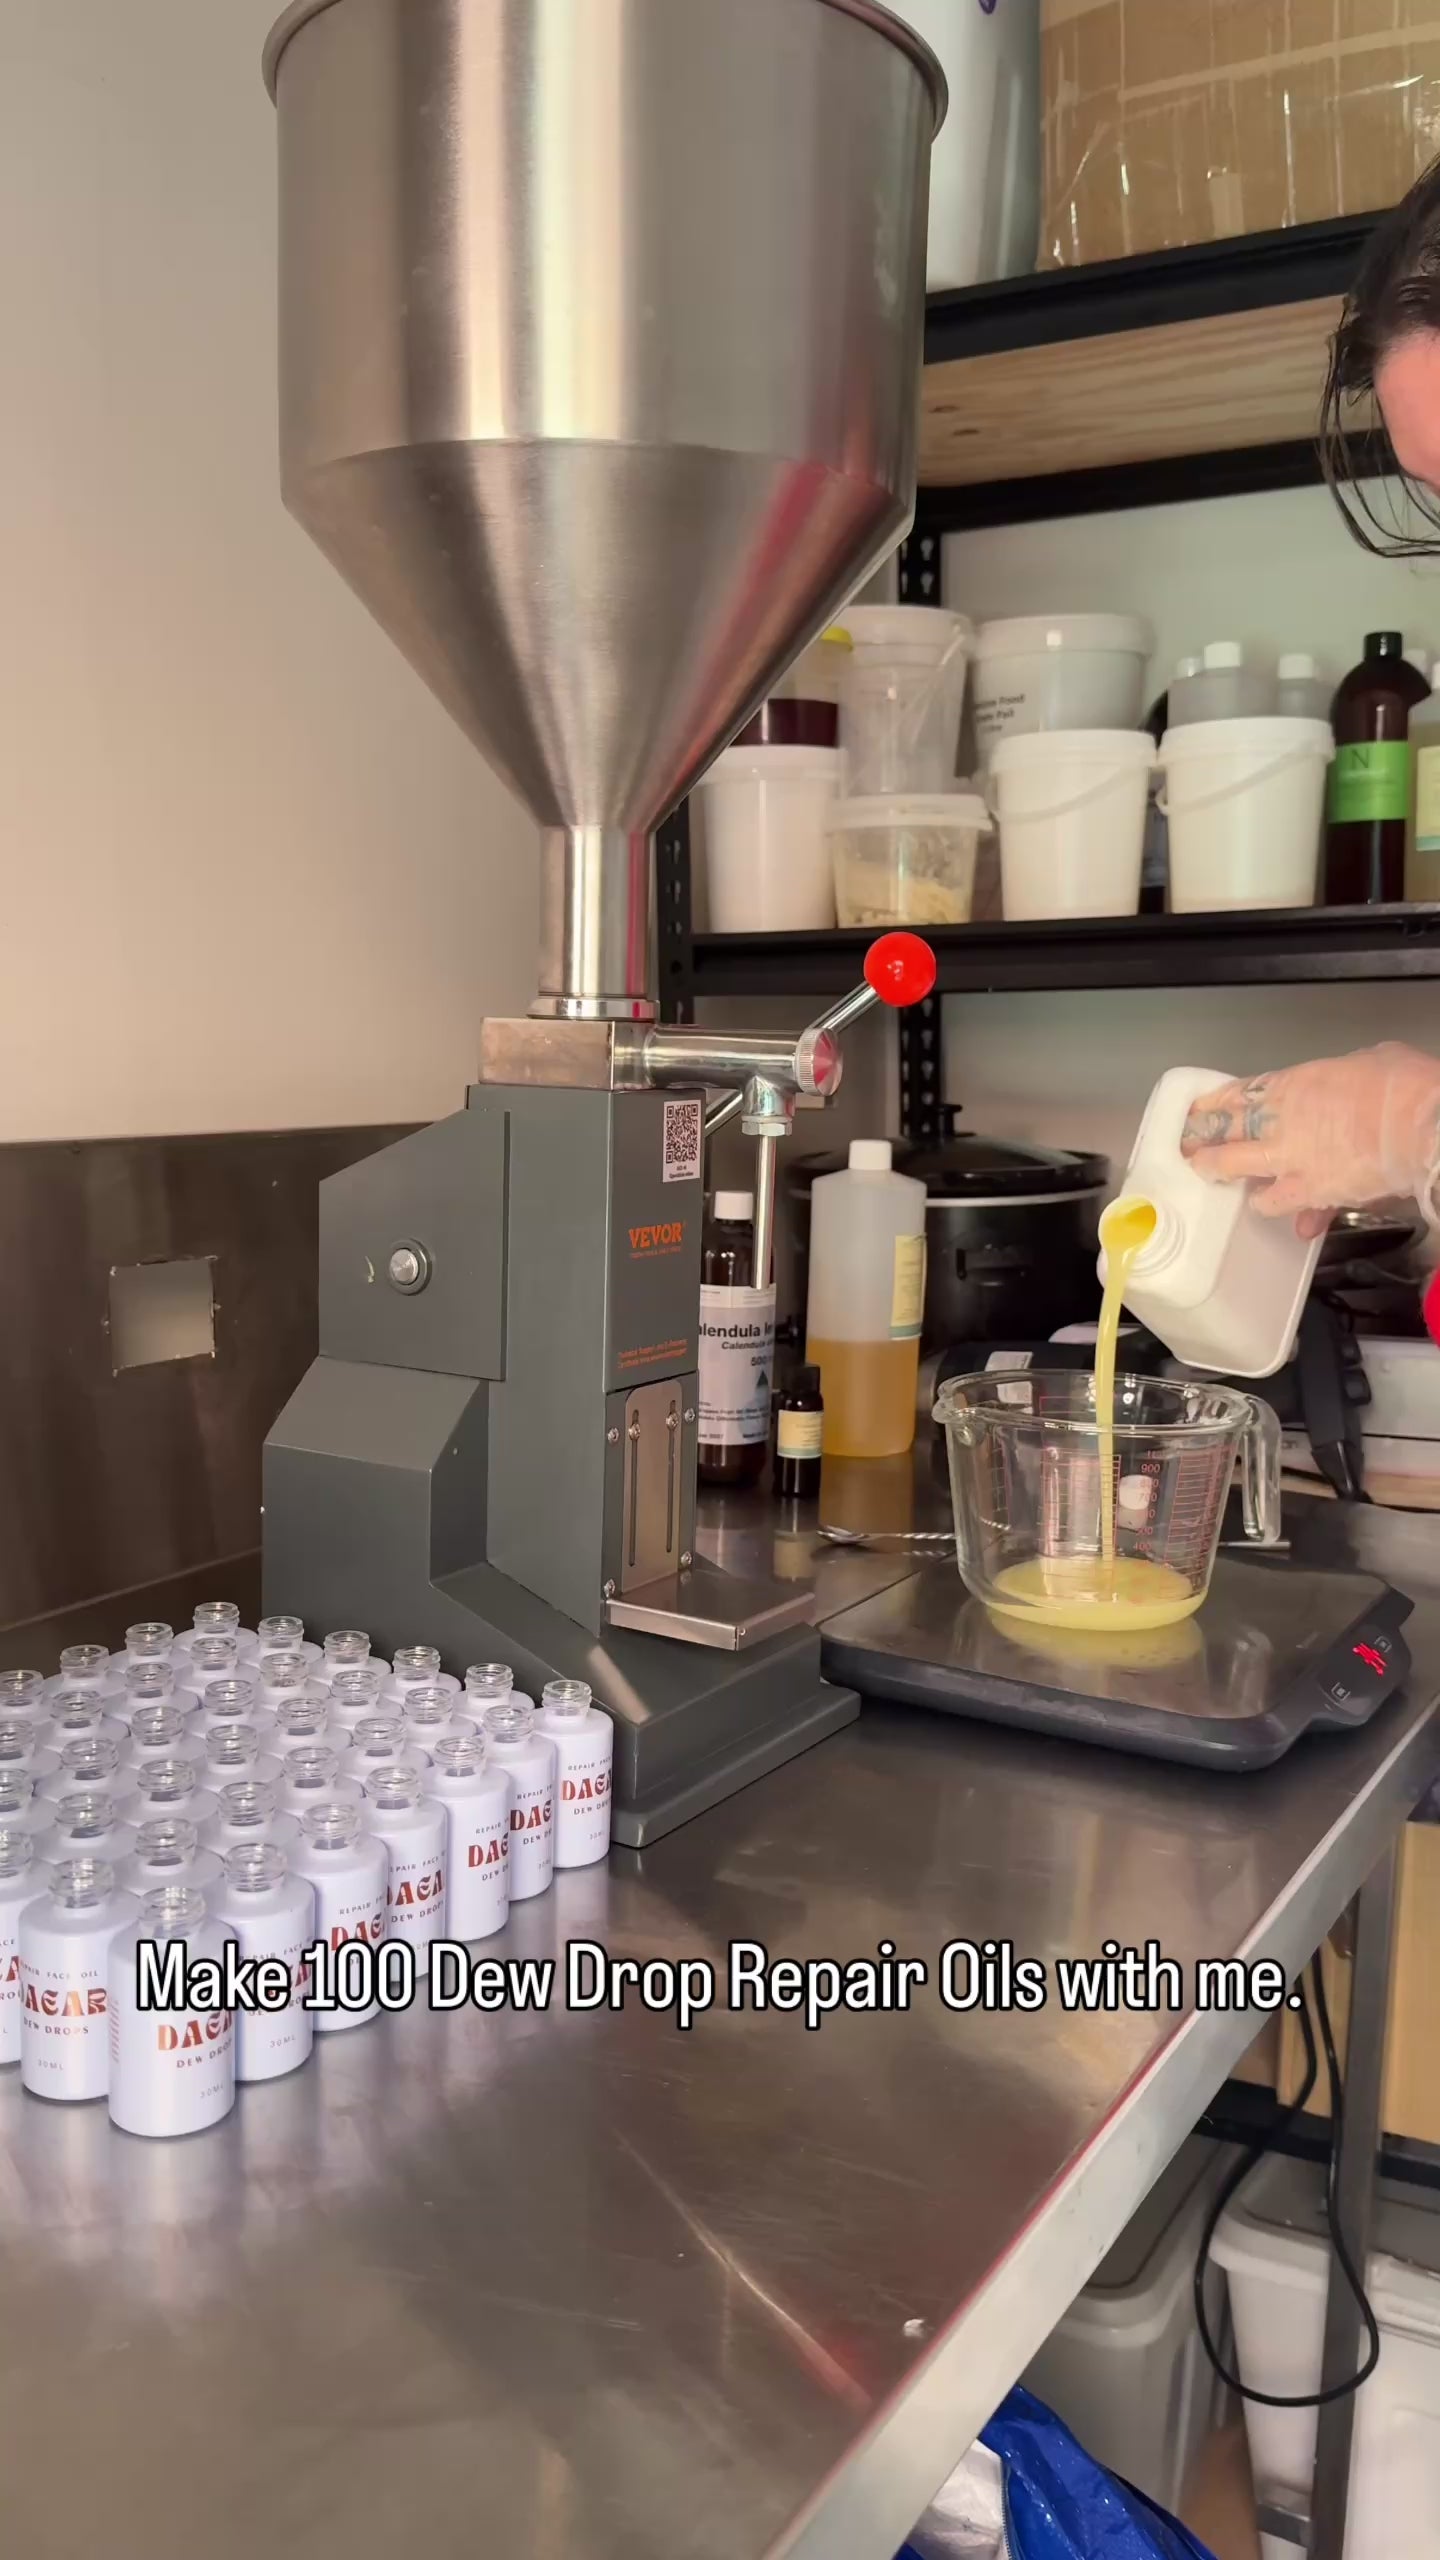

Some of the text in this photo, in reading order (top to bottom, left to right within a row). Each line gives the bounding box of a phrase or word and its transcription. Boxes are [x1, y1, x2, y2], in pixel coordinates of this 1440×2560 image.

[628, 1222, 683, 1249] VEVOR
[1141, 1463, 1160, 1473] 900
[573, 1806, 593, 1816] DEW
[523, 1834, 542, 1846] DEW
[391, 1914, 414, 1924] DEW
[81, 1970, 98, 1978] OIL
[177, 2055, 203, 2069] DEW
